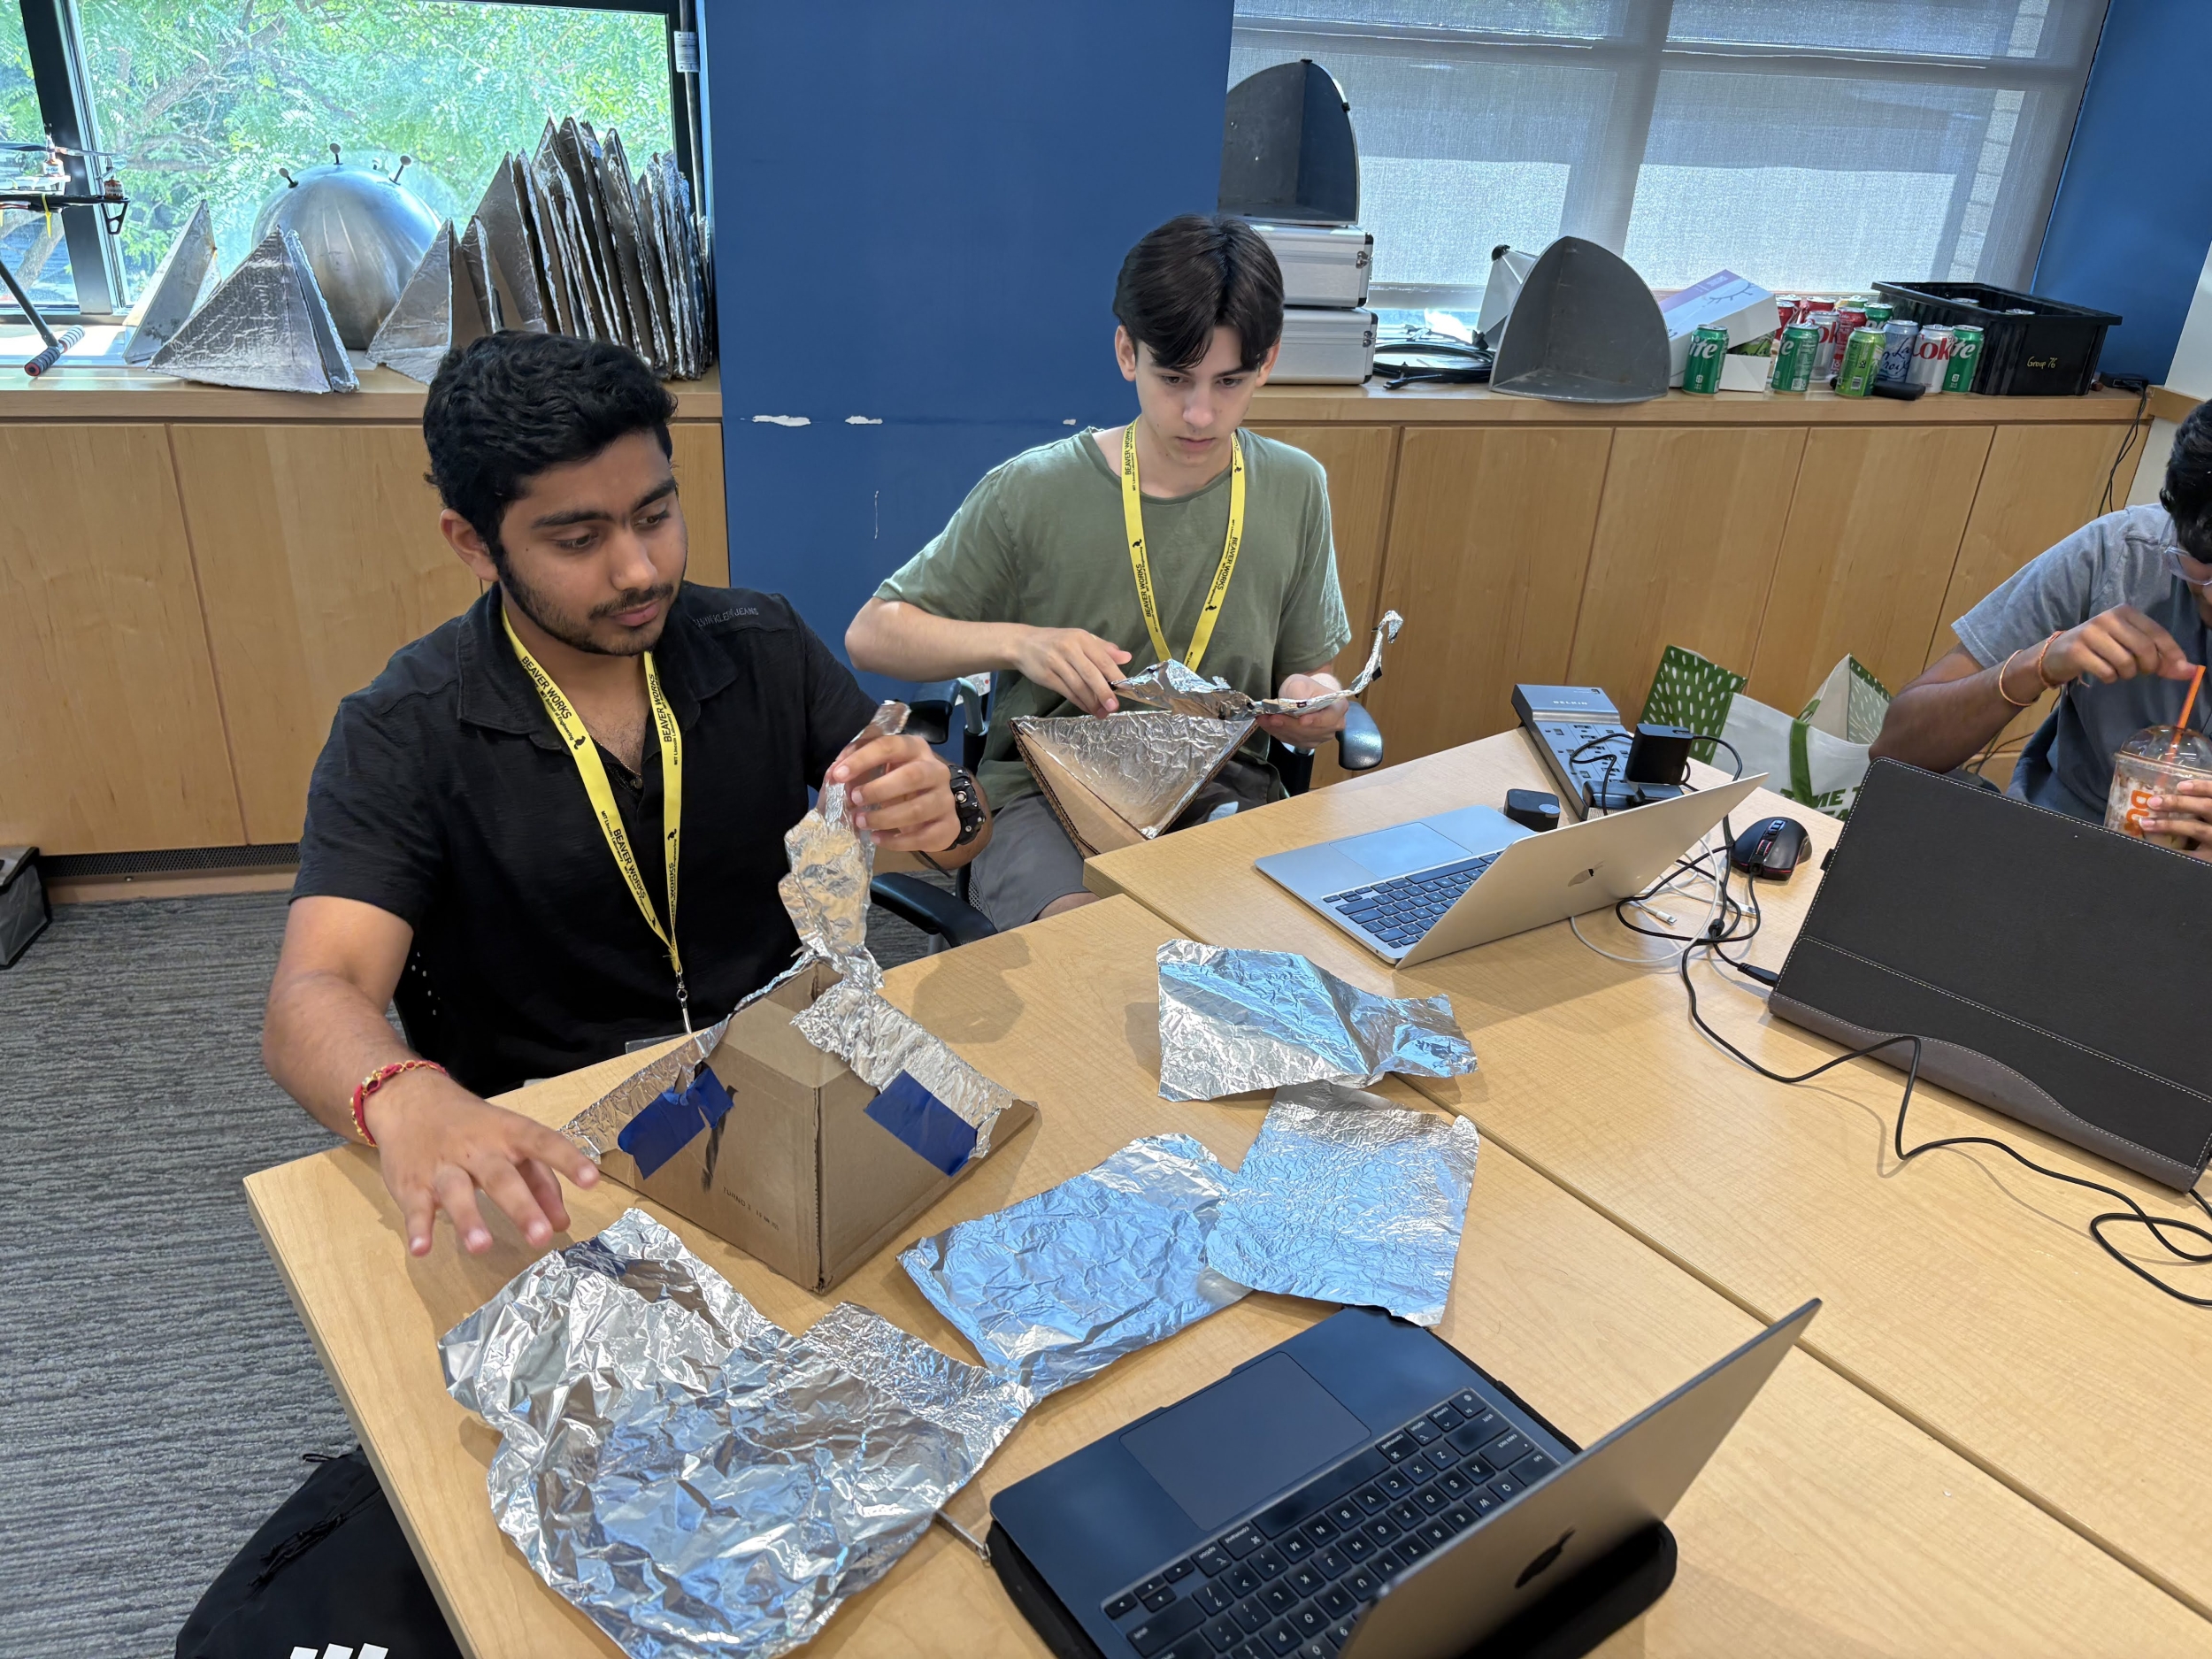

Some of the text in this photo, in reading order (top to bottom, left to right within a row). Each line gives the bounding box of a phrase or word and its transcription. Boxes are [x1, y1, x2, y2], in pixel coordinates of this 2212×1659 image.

[1690, 336, 1718, 359] ite
[2026, 356, 2058, 370] Group 76
[1217, 536, 1238, 591] BEAVER WORKS
[1136, 564, 1152, 618] BEAVER WORKS
[734, 607, 759, 616] JEANS
[521, 656, 550, 690] BEAVER
[547, 687, 572, 719] WORKS
[649, 673, 662, 706] WORKS
[657, 707, 672, 742] BEAVER
[613, 828, 633, 864] BEAVER
[628, 864, 647, 899] WORKS
[1432, 1407, 1449, 1418] control
[1410, 1421, 1425, 1432] option
[1381, 1433, 1404, 1450] command
[1436, 1451, 1447, 1460] Z
[1413, 1465, 1423, 1474] X
[1471, 1465, 1481, 1474] A
[1390, 1480, 1399, 1489] C
[1449, 1479, 1459, 1489] S
[1502, 1483, 1511, 1492] Q
[1425, 1494, 1436, 1503] D
[1479, 1498, 1491, 1509] W
[1340, 1509, 1351, 1519] B
[1402, 1510, 1411, 1519] F
[1455, 1513, 1465, 1523] E
[1225, 1525, 1250, 1544] command
[1315, 1525, 1326, 1535] N
[1377, 1525, 1386, 1534] G
[1432, 1529, 1442, 1539] R
[1289, 1541, 1301, 1552] M
[1352, 1541, 1362, 1550] H
[1409, 1546, 1418, 1555] T
[1198, 1546, 1217, 1560] option
[1327, 1557, 1334, 1567] J
[1384, 1562, 1393, 1571] Y
[1300, 1574, 1310, 1585] K
[1357, 1578, 1368, 1588] U
[1272, 1592, 1283, 1601] L
[1332, 1596, 1340, 1605] I
[1304, 1613, 1314, 1624] O
[1278, 1631, 1287, 1642] P
